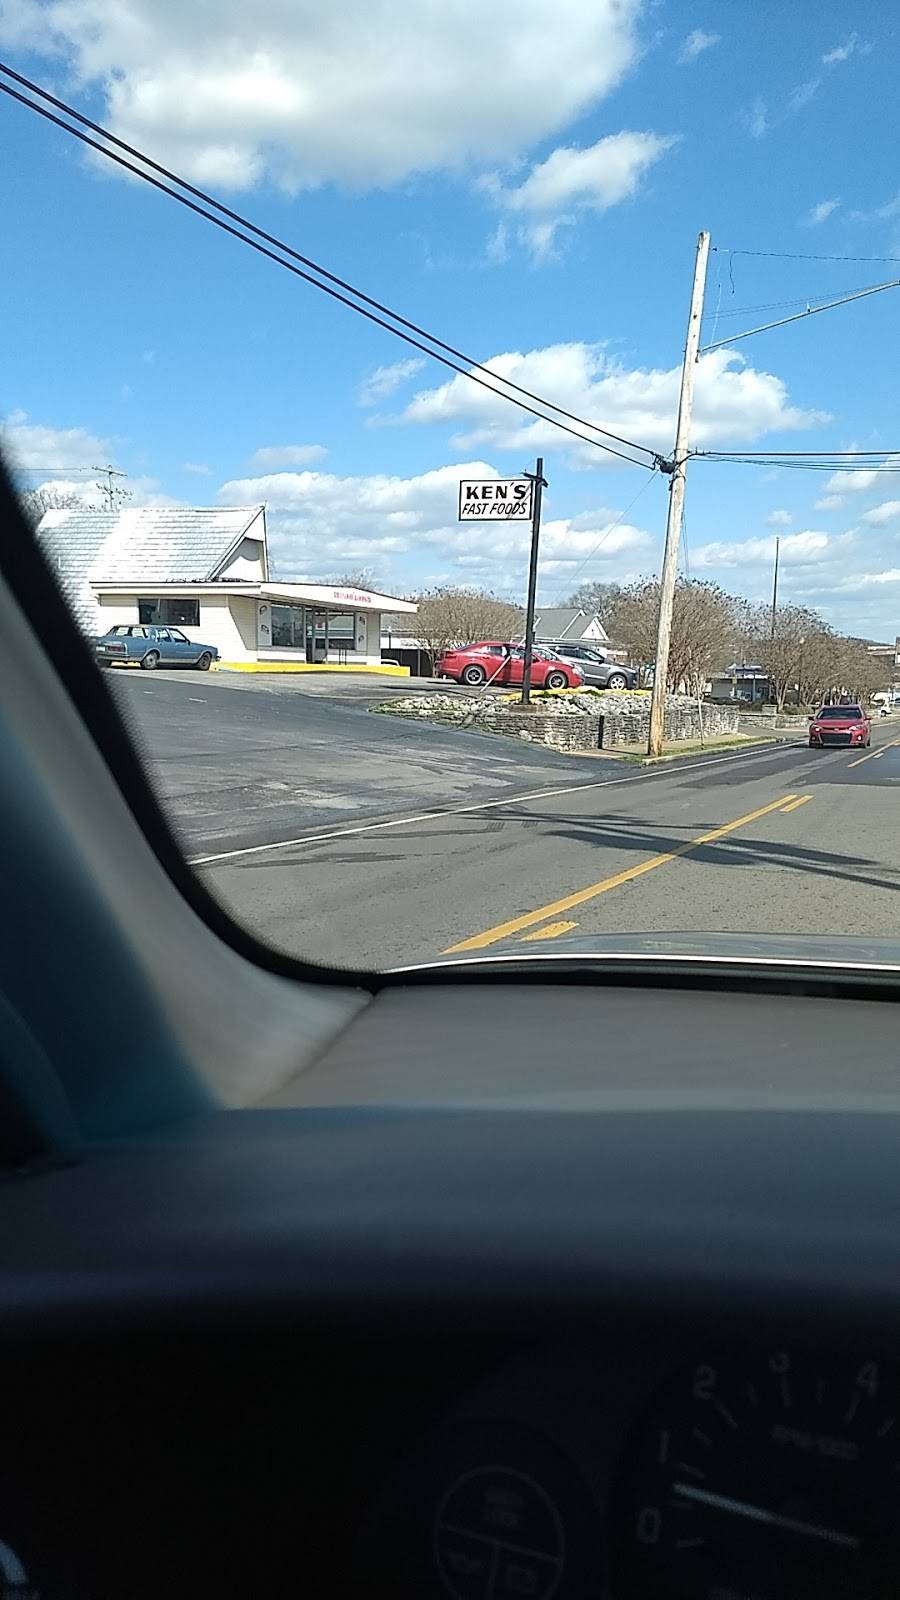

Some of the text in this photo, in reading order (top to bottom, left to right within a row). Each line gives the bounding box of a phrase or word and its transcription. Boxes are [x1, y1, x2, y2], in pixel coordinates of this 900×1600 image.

[462, 502, 528, 515] FAST FOODS
[466, 482, 527, 500] KEN'S
[693, 1365, 718, 1400] 2
[856, 1361, 878, 1396] 4
[637, 1507, 662, 1544] 0
